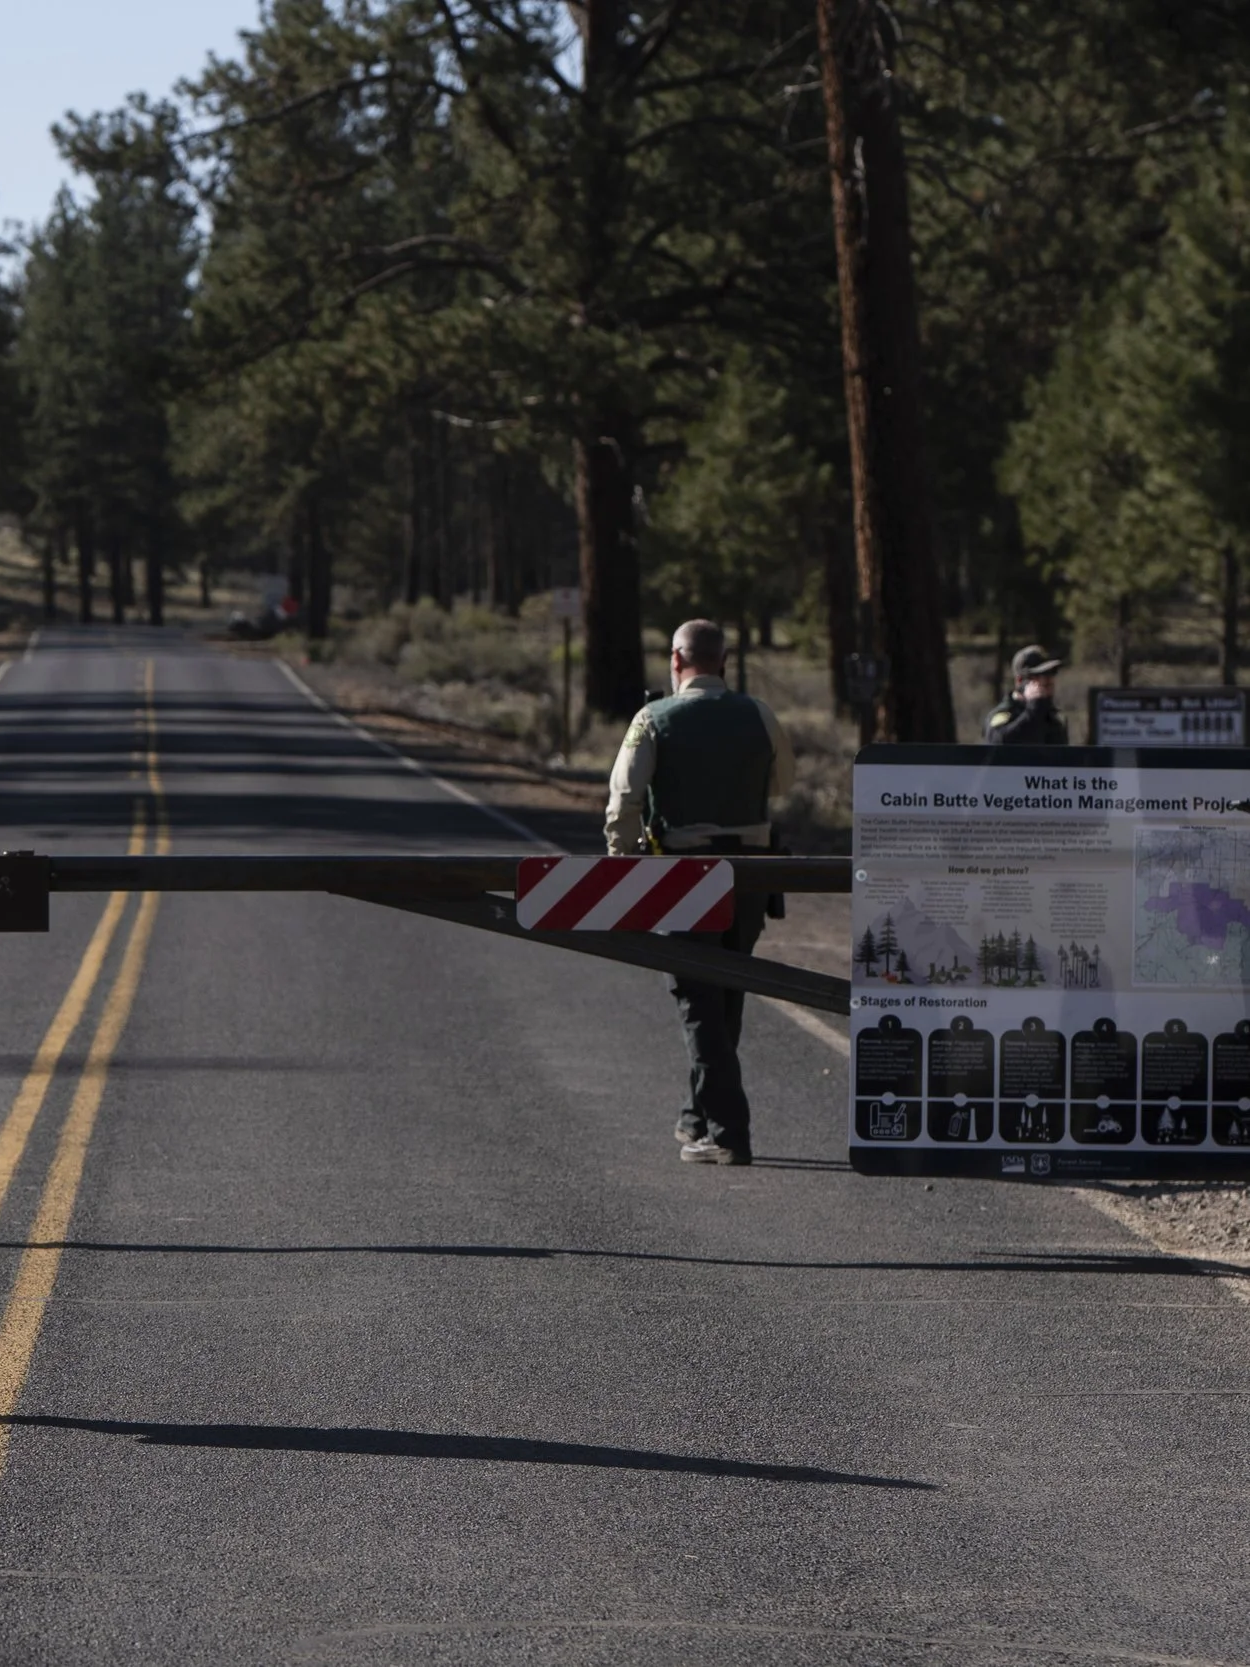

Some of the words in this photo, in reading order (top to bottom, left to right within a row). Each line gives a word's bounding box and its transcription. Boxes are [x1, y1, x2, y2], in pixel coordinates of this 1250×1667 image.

[1025, 775, 1068, 790] What
[1073, 775, 1087, 790] is
[1091, 776, 1118, 791] the
[880, 791, 928, 807] Cabin
[933, 792, 979, 808] Butte
[983, 793, 1073, 812] Vegetation
[1078, 794, 1188, 813] Management
[992, 867, 1005, 875] get
[1007, 866, 1029, 874] here?
[860, 995, 901, 1008] Stages
[904, 996, 916, 1006] of
[919, 997, 987, 1007] Restoration
